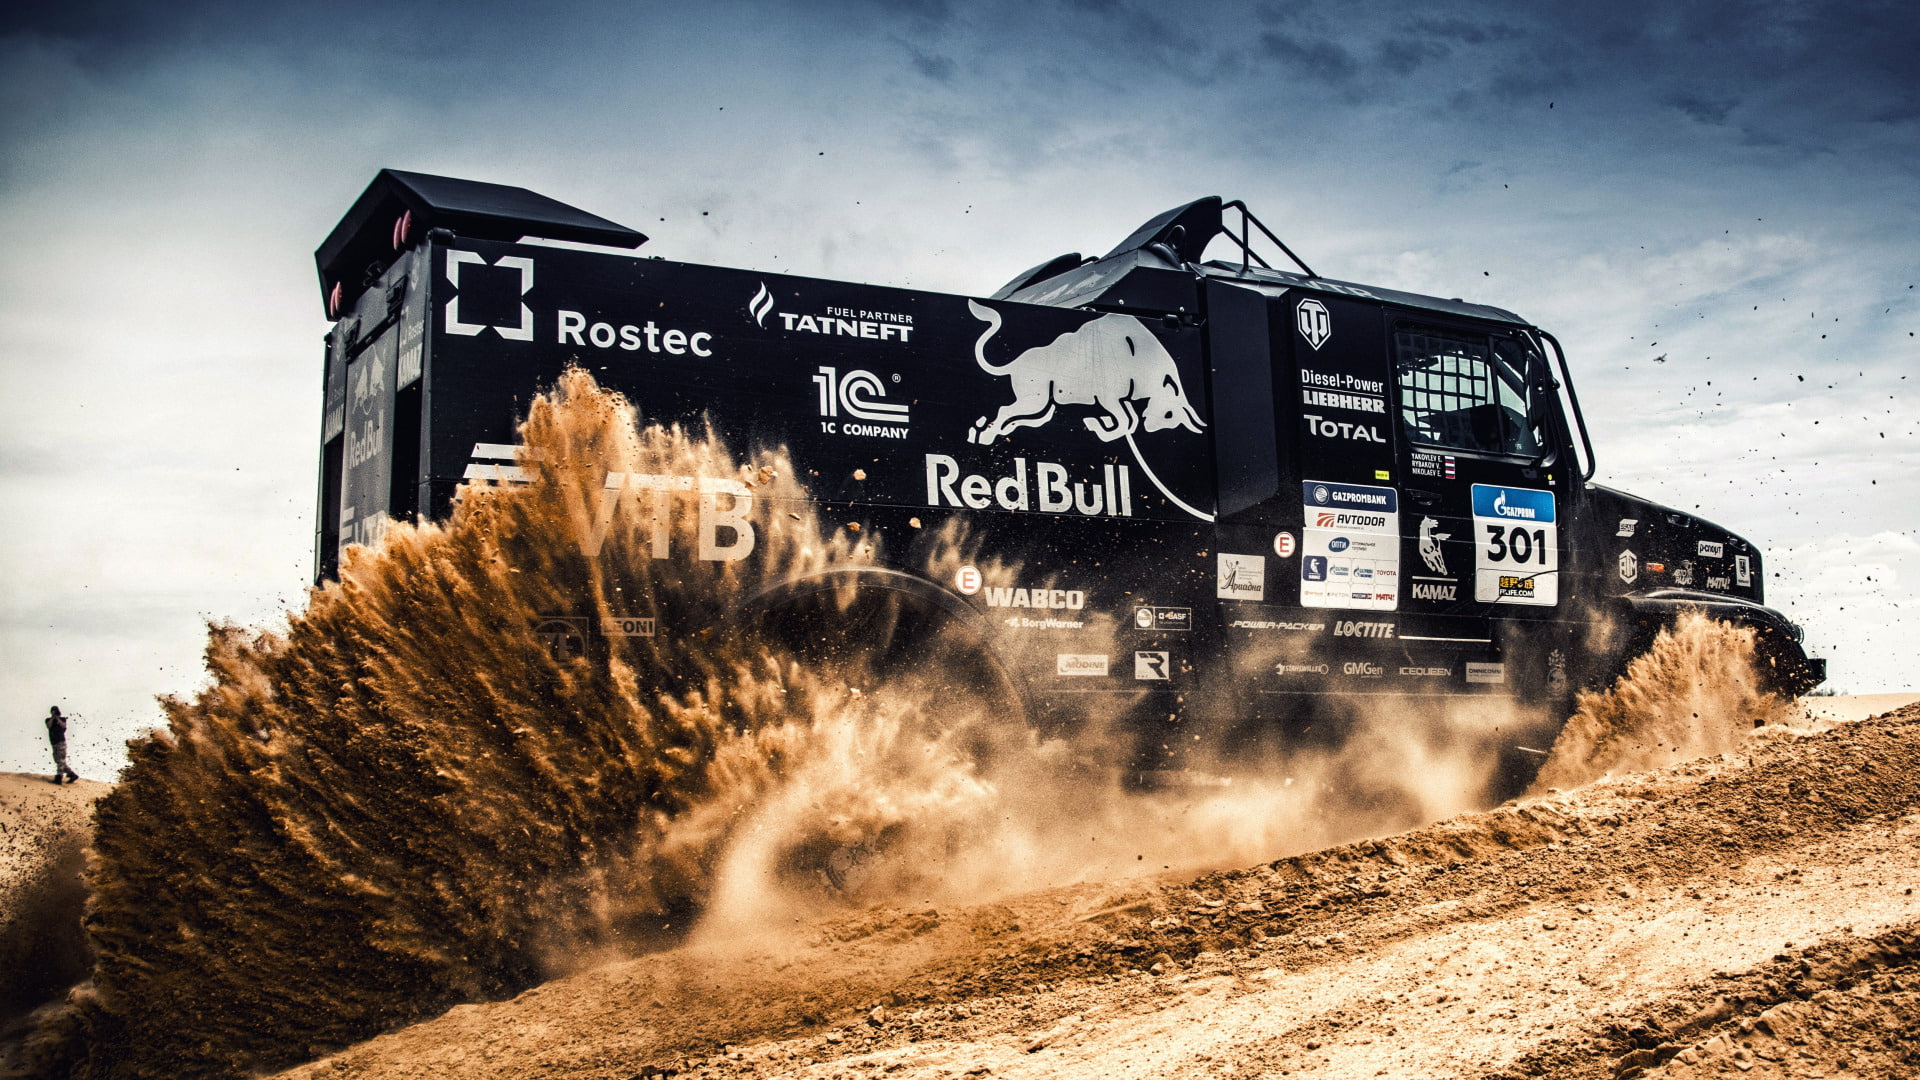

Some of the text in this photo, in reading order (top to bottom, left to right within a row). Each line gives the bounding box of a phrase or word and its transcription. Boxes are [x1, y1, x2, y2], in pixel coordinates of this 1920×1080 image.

[826, 306, 913, 324] FUEL PARTNER
[557, 309, 713, 357] Rostec
[779, 312, 914, 342] TATNEFT
[1301, 368, 1385, 393] Diesel-Power
[1302, 389, 1386, 414] LIEBHERR
[820, 421, 910, 440] 1C COMPANY
[1303, 414, 1387, 443] TOTAL
[1411, 453, 1437, 462] YAKOVLEV
[1412, 468, 1436, 476] NIKOLAEV
[925, 453, 1132, 517] Red Bull
[1332, 491, 1387, 505] GAZPROMBANK
[562, 471, 756, 562] VTB
[1336, 513, 1386, 527] AVTODOR
[1507, 506, 1536, 518] GAZPROM
[1279, 537, 1290, 553] E
[1486, 524, 1546, 565] 301
[962, 571, 975, 589] E
[983, 586, 1085, 610] WABCO
[1411, 583, 1457, 601] KAMAZ
[1021, 617, 1084, 630] BorgWarner
[1232, 620, 1326, 631] POWER-PACKER
[1333, 620, 1396, 638] LOCTITE
[1065, 660, 1106, 669] MODINE
[1400, 667, 1452, 677] ICEQUEEN
